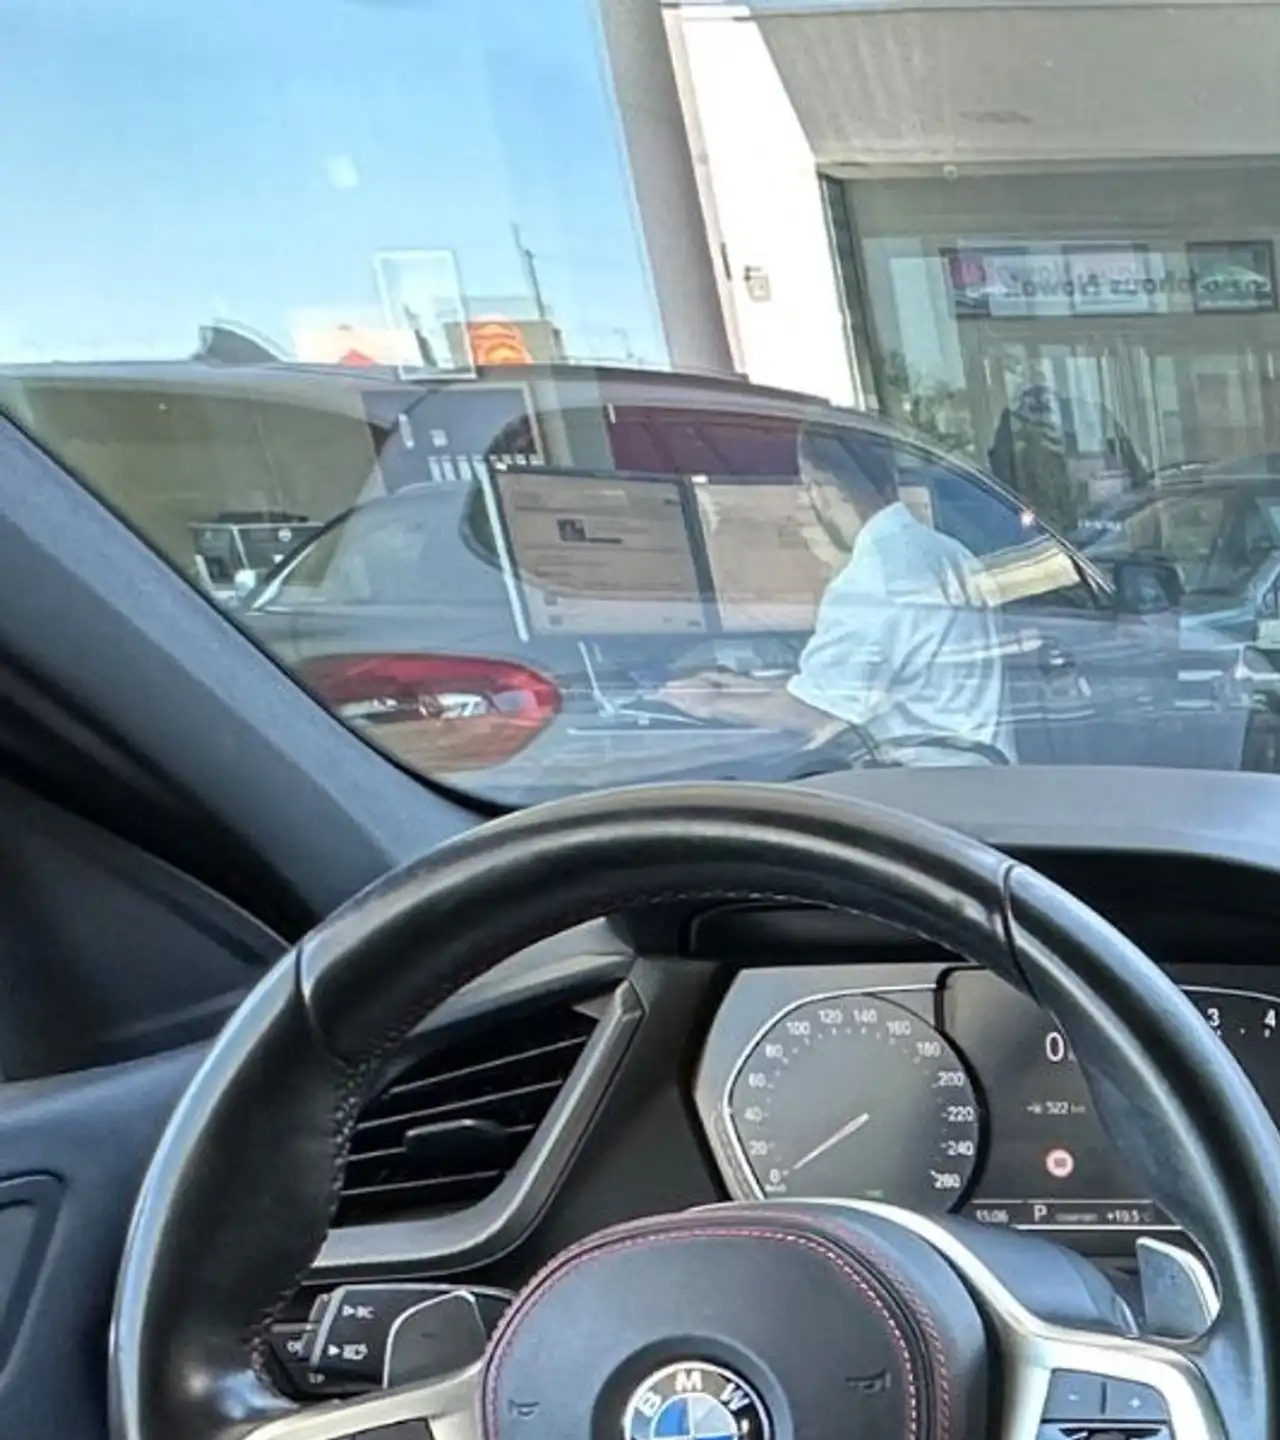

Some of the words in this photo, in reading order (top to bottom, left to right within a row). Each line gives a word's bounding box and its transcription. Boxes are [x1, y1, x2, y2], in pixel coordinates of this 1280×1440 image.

[818, 1009, 843, 1024] 120
[853, 1009, 878, 1024] 140
[1207, 1008, 1220, 1027] 3
[1264, 1009, 1276, 1028] 4
[786, 1021, 811, 1035] 100
[887, 1020, 912, 1035] 160
[765, 1043, 784, 1057] 80
[916, 1042, 941, 1057] 180
[1045, 1031, 1065, 1063] 0
[748, 1073, 766, 1087] 60
[938, 1072, 964, 1087] 200
[744, 1107, 763, 1121] 40
[947, 1107, 974, 1121] 220
[749, 1141, 768, 1155] 20
[947, 1141, 974, 1155] 240
[769, 1168, 781, 1183] 0
[934, 1173, 961, 1189] 260
[1034, 1204, 1047, 1222] P
[636, 1370, 750, 1418] BMW
